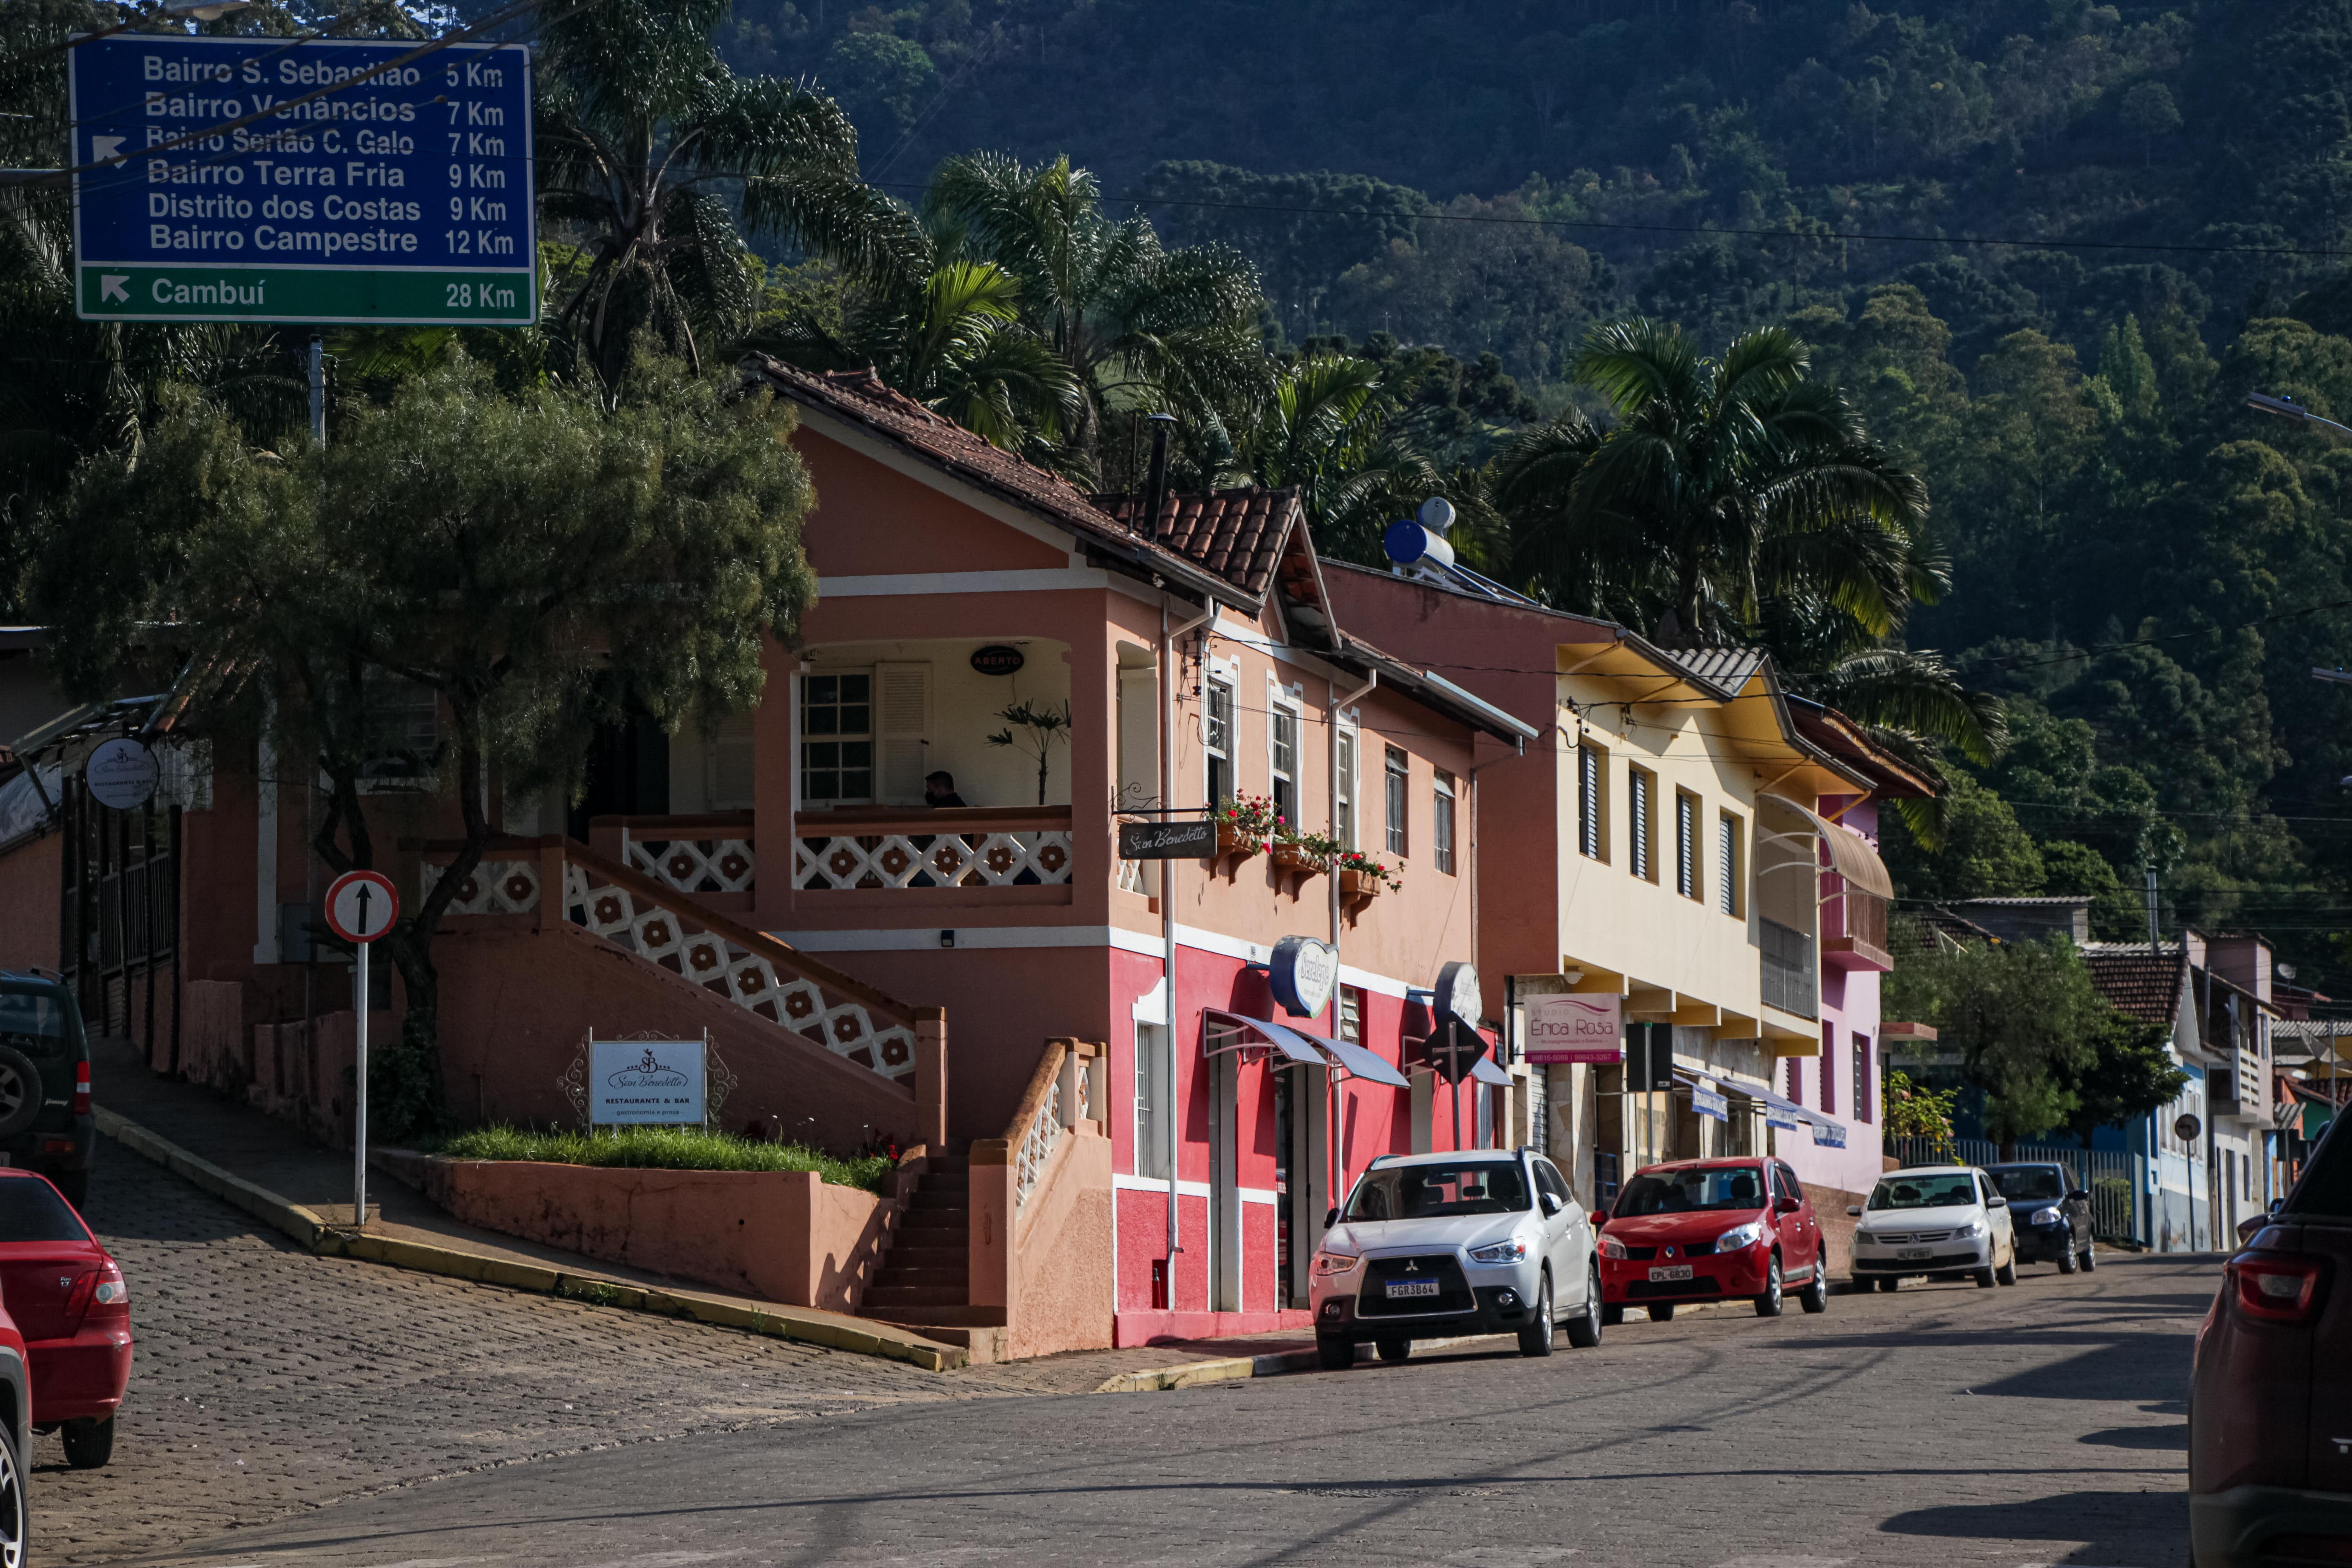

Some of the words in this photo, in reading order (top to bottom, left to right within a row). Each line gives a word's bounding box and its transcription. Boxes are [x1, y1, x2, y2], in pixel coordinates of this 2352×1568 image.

[144, 56, 232, 83] Bairro
[242, 59, 269, 83] S.
[447, 64, 459, 87] 5
[467, 62, 503, 87] Km
[146, 92, 242, 118] Bairro
[252, 95, 416, 122] Venâncios
[447, 102, 460, 125] 7
[468, 102, 504, 126] Km
[147, 126, 224, 151] Bairro
[233, 127, 314, 153] Sertão
[323, 130, 348, 153] C.
[357, 130, 414, 154] Galo
[448, 133, 461, 156] 7
[470, 133, 505, 156] Km
[148, 159, 244, 185] Bairro
[254, 161, 335, 186] Terra
[347, 162, 405, 186] Fria
[450, 164, 461, 188] 9
[470, 164, 505, 188] Km
[149, 193, 252, 218] Distrito
[262, 195, 314, 220] dos
[323, 195, 421, 221] Costas
[450, 196, 462, 220] 9
[471, 196, 506, 221] Km
[151, 225, 244, 250] Bairro
[255, 225, 418, 257] Campestre
[446, 230, 470, 254] 12
[479, 230, 514, 254] Km
[152, 278, 265, 304] Cambuí
[446, 284, 471, 307] 28
[480, 284, 515, 307] Km
[975, 657, 1020, 665] ABERTO
[1531, 1018, 1569, 1036] Érica
[1576, 1019, 1613, 1034] Rosa
[613, 1076, 636, 1088] San
[638, 1075, 682, 1088] Benedetto
[1392, 1284, 1434, 1296] FGR3B64
